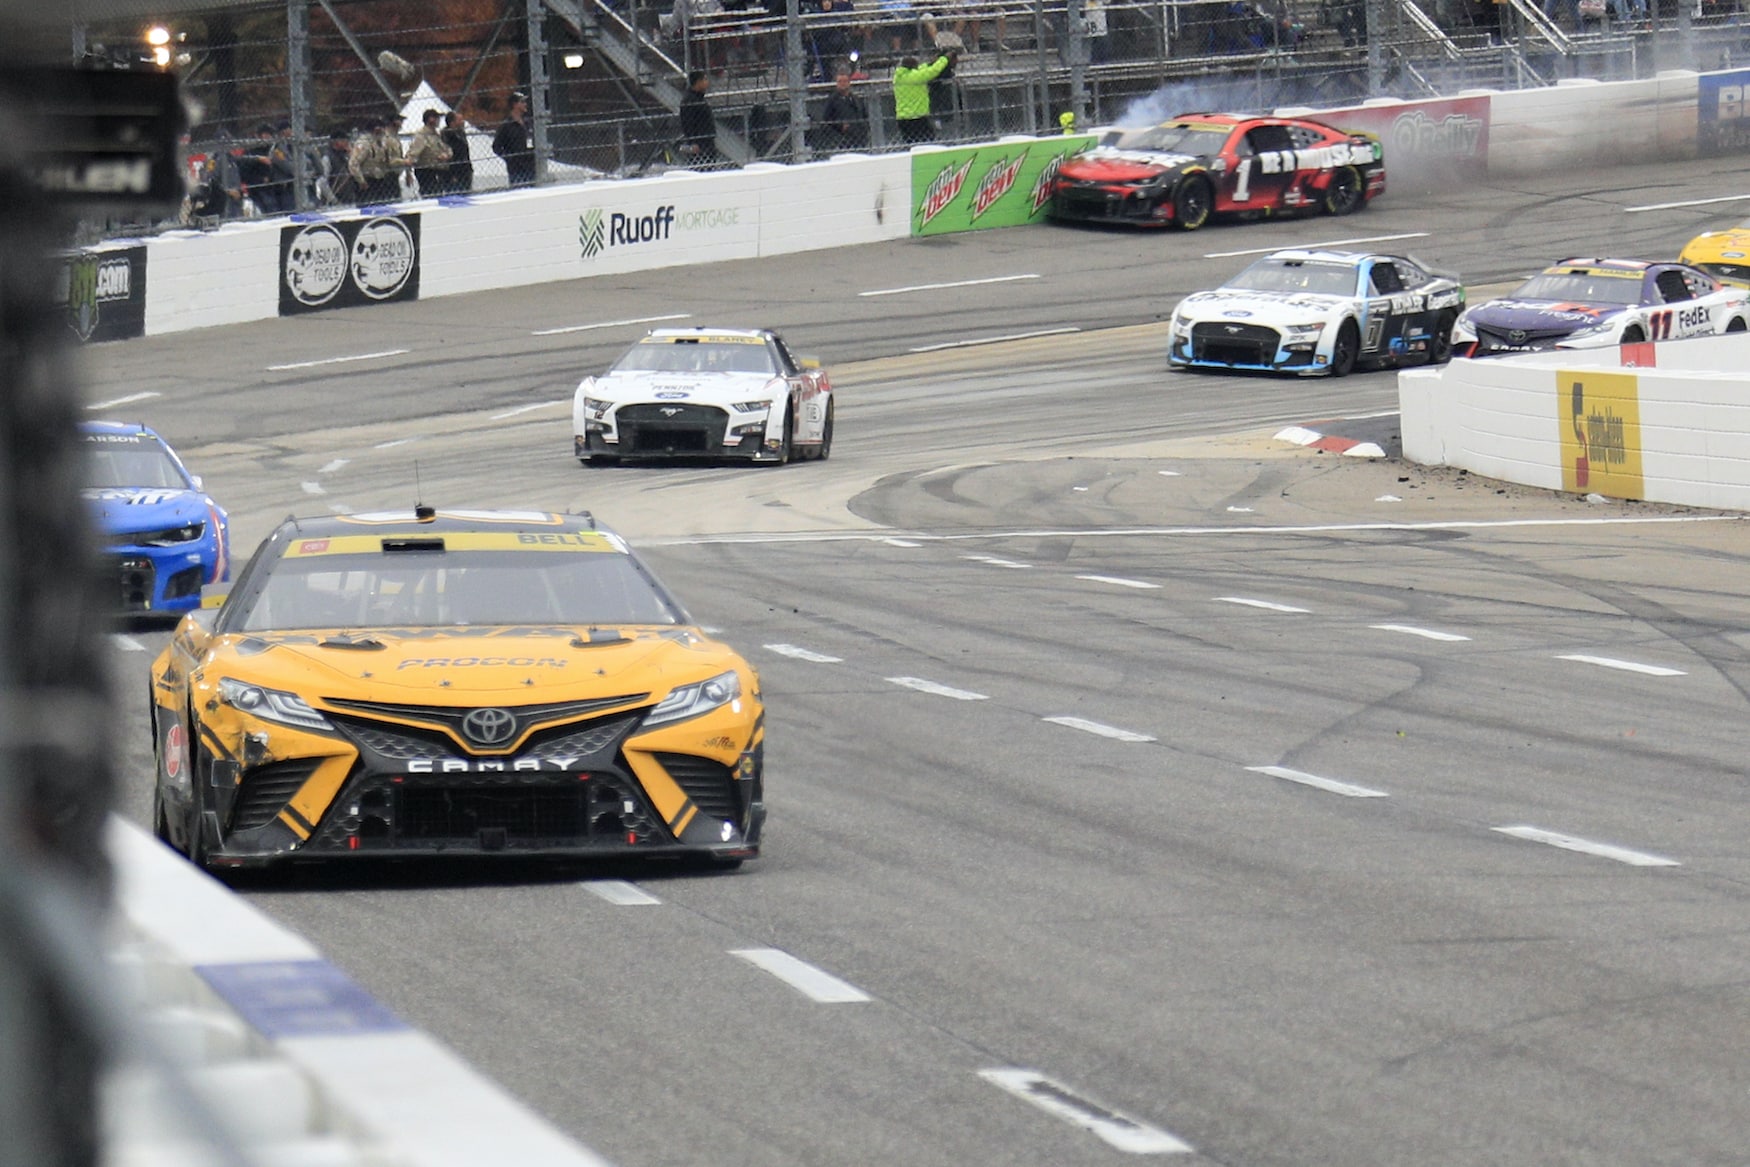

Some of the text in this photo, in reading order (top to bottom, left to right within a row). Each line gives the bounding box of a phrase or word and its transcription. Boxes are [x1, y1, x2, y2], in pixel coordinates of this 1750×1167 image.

[1232, 159, 1251, 201] 1
[610, 205, 740, 246] Ruoff MORTGAGE
[314, 266, 340, 282] TOOLS
[380, 259, 406, 276] TOOLS
[96, 265, 129, 297] .com
[1650, 309, 1673, 340] 11
[1679, 305, 1711, 329] FedEx
[86, 435, 140, 443] ARSON
[517, 533, 596, 547] BELL
[397, 657, 569, 671] PROCON
